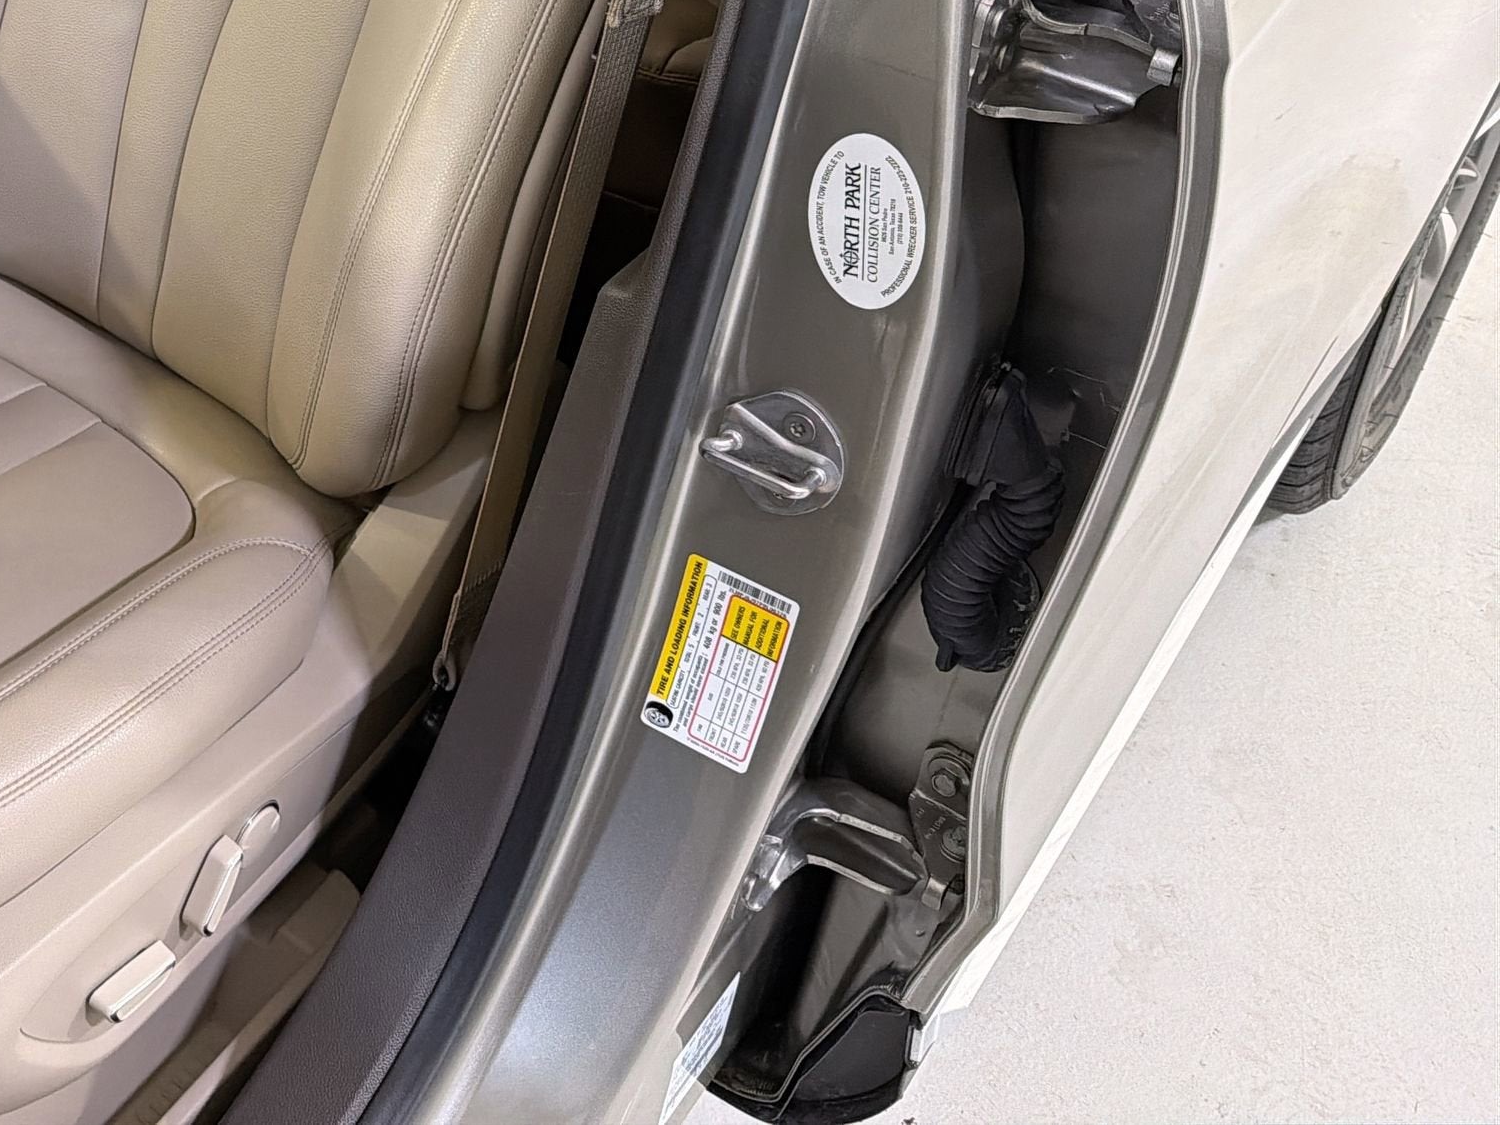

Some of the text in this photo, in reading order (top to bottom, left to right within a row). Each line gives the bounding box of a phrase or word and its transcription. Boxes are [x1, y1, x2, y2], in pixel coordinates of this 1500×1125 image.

[834, 151, 844, 160] TO
[822, 159, 838, 184] VEHICLE
[817, 185, 826, 200] TOW
[841, 163, 860, 278] NORTH PARK
[907, 196, 917, 224] SERVICE
[867, 167, 881, 282] COLLISION CENTER
[818, 236, 826, 245] AN
[820, 247, 828, 256] OF
[907, 227, 916, 257] WRECKER
[824, 258, 836, 275] CASE
[881, 260, 912, 297] PROFESSIONAL
[712, 618, 718, 626] or
[713, 602, 723, 616] 900
[657, 561, 703, 696] TIRE AND LOADING INFORMATION
[707, 626, 717, 636] kg
[730, 606, 746, 640] SEE OWNERS
[742, 610, 757, 646] MANUAL FOR
[755, 618, 770, 650] ADDITIONAL
[703, 636, 713, 650] 408
[766, 620, 783, 658] INFORMATION
